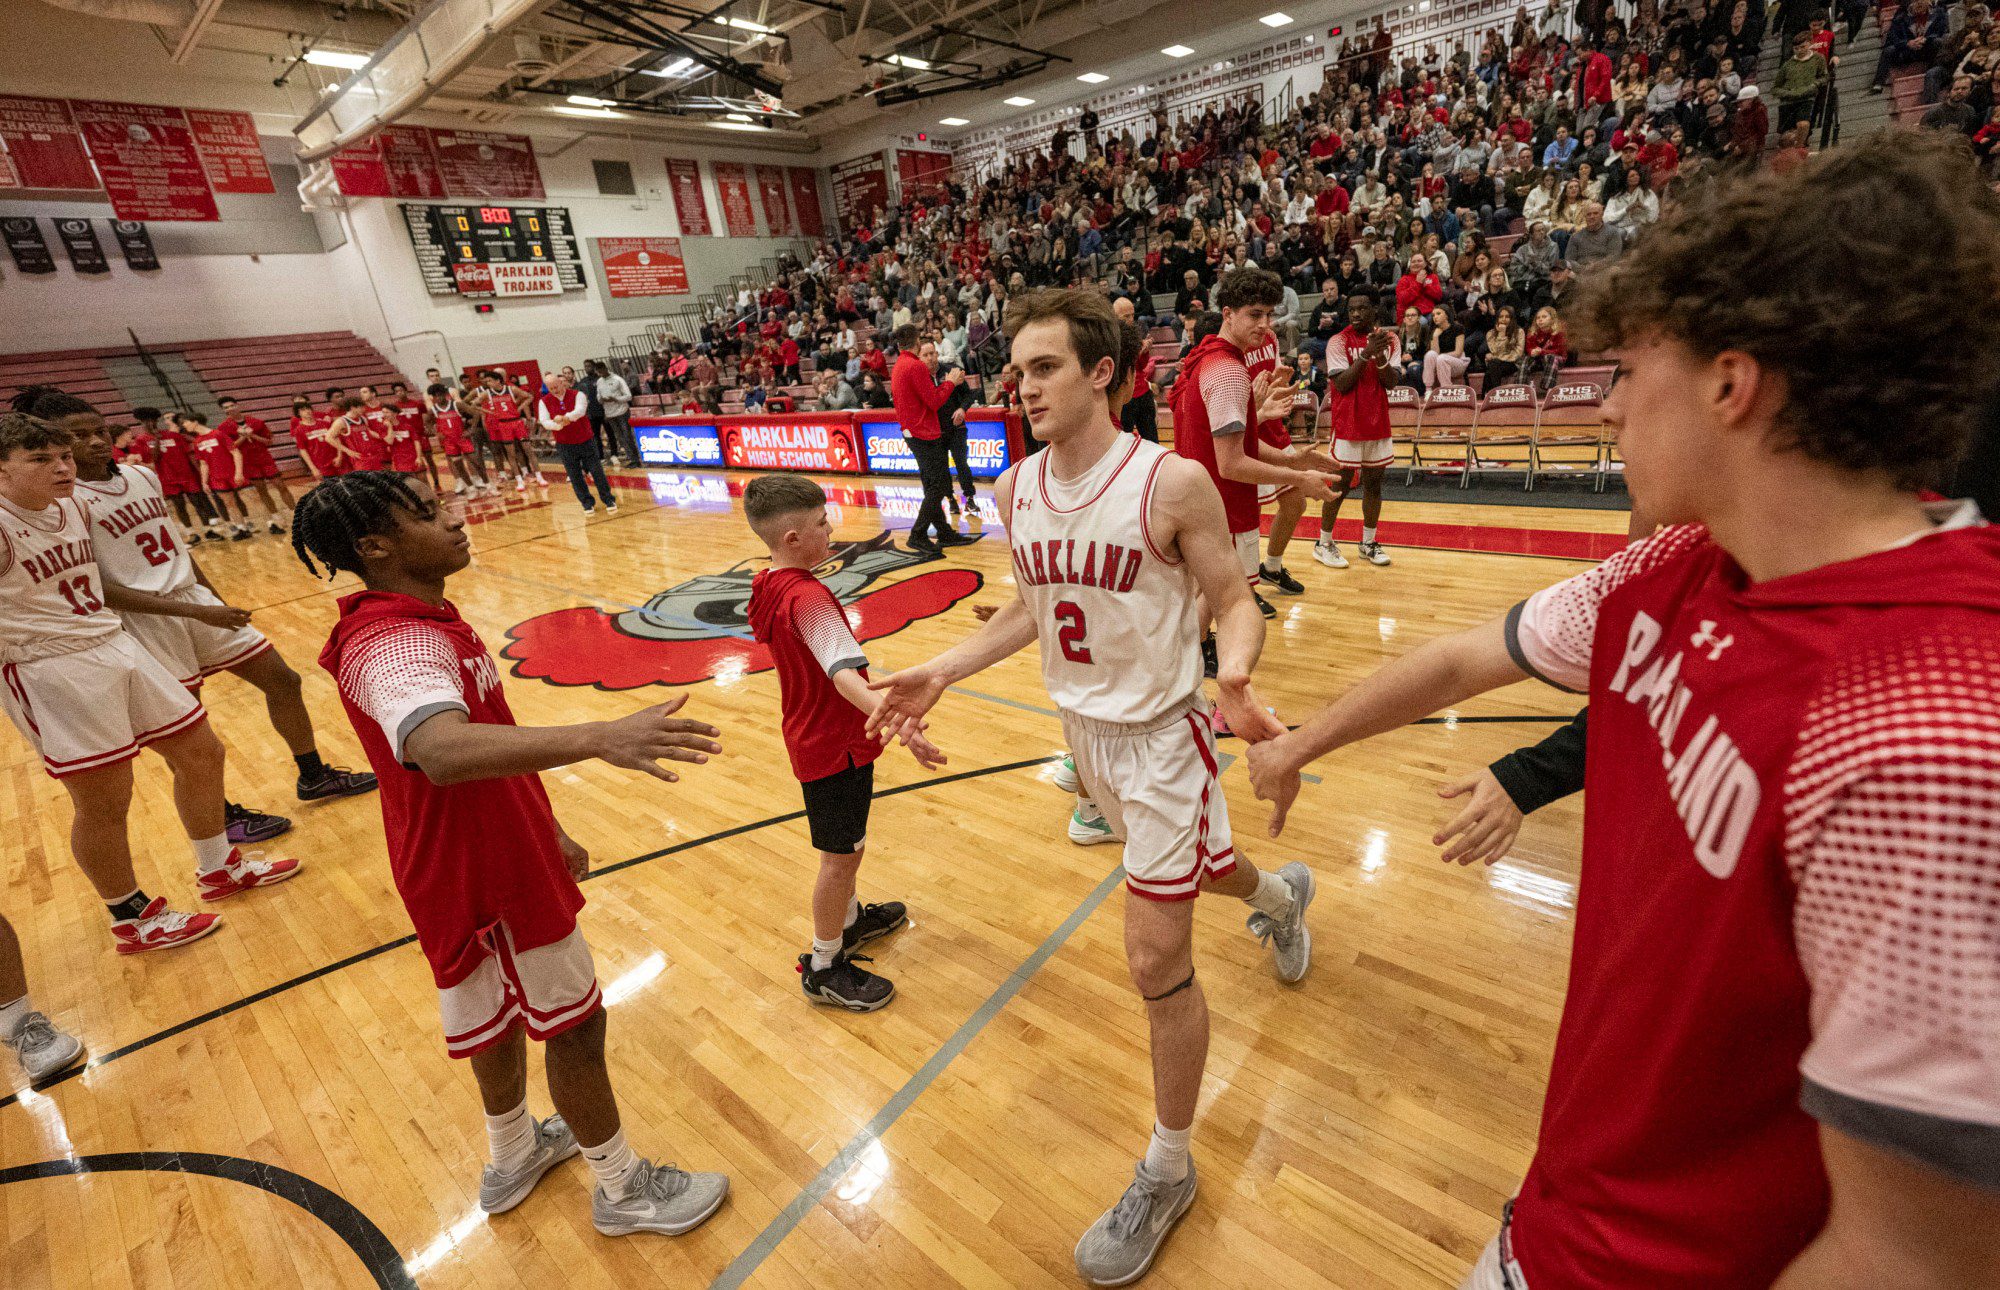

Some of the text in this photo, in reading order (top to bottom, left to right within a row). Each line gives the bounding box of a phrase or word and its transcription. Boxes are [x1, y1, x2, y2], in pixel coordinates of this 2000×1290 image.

[480, 207, 512, 224] 8:00
[457, 216, 469, 231] 0
[528, 217, 540, 231] 0
[504, 226, 511, 238] 1
[461, 245, 473, 258] 0
[532, 245, 543, 257] 0
[495, 266, 553, 278] PARKLAND
[502, 281, 553, 292] TROJANS
[1438, 388, 1467, 396] PHS
[1495, 387, 1525, 398] PHS
[1558, 386, 1592, 395] PHS
[741, 426, 829, 449] PARKLAND
[747, 450, 832, 468] HIGH SCHOOL
[990, 458, 1003, 468] TV
[135, 524, 179, 567] 24
[58, 575, 103, 616] 13
[1053, 600, 1095, 665] 2
